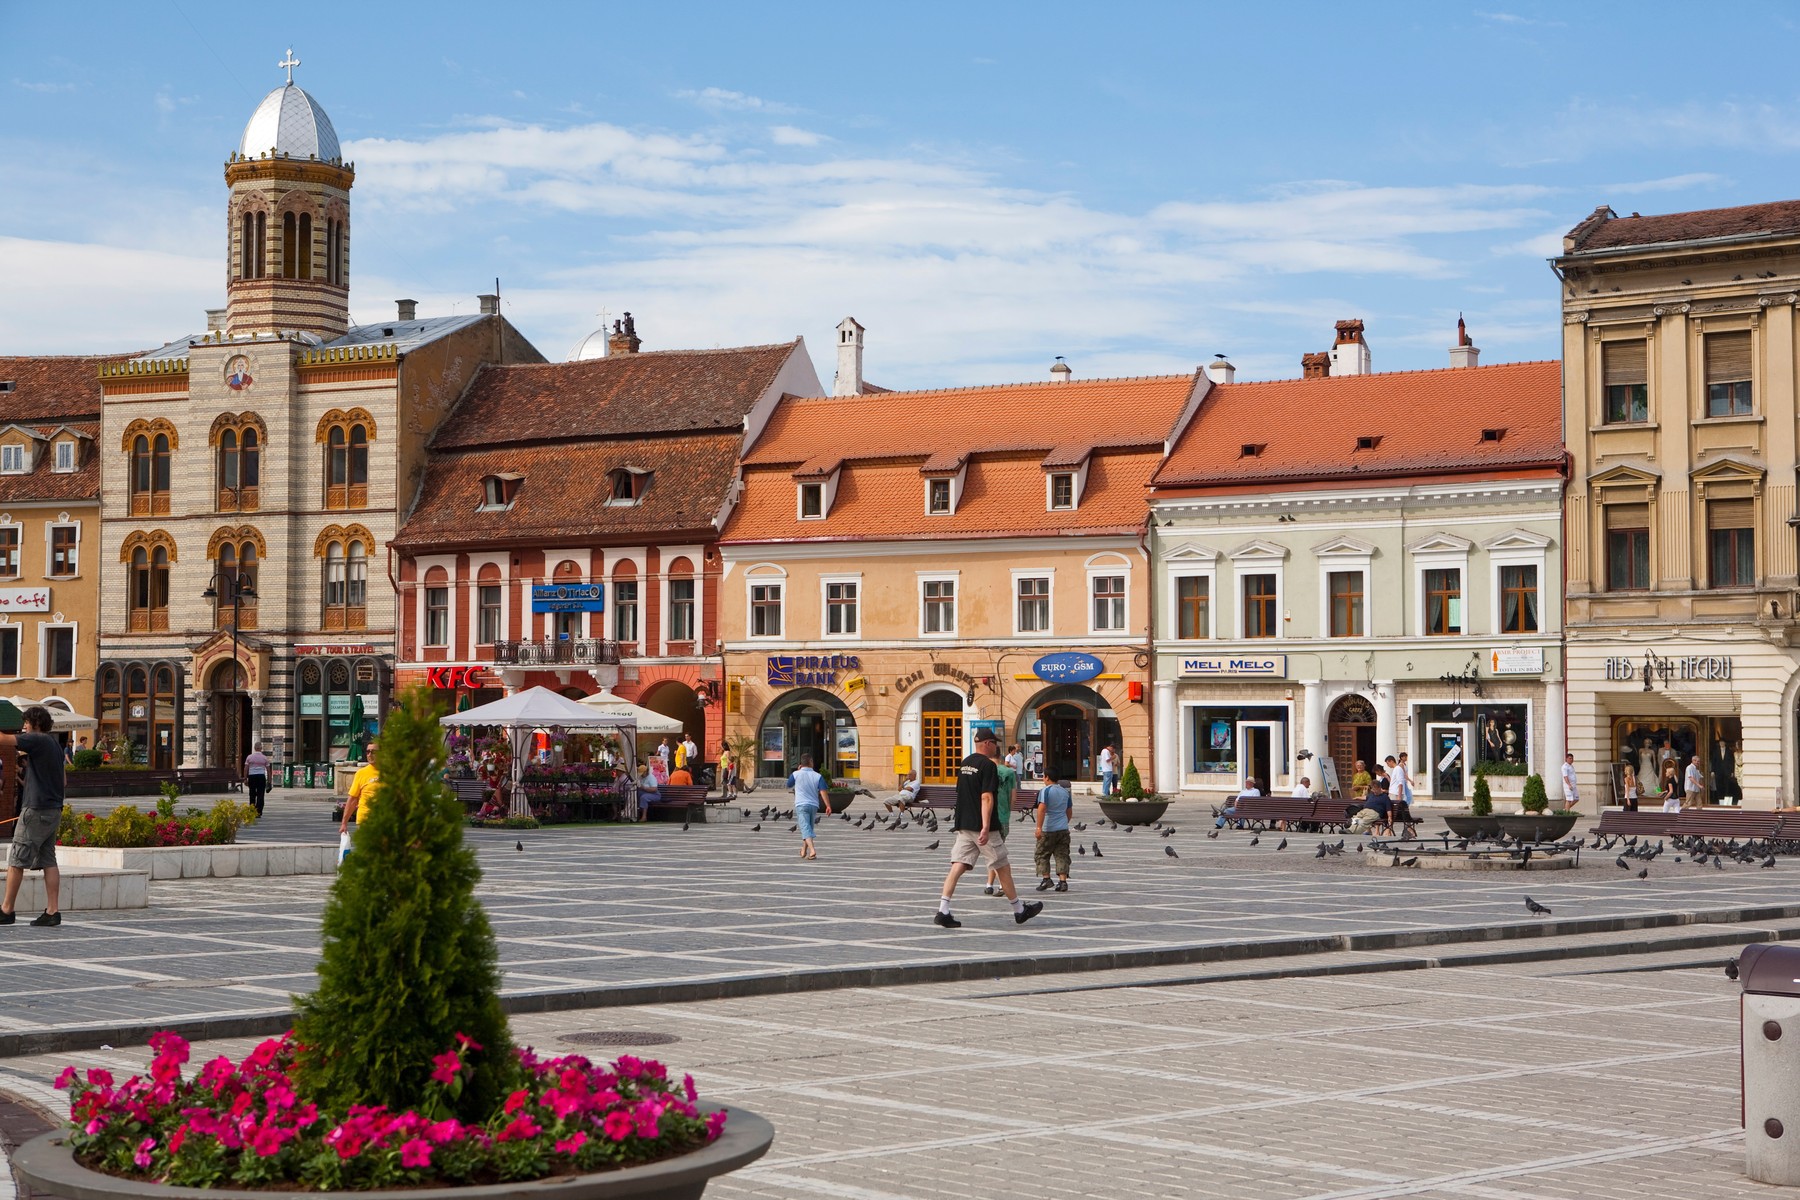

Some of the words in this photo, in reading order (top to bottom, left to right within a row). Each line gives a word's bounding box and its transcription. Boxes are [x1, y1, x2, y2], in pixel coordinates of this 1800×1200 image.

[533, 589, 557, 597] Allianz
[16, 593, 46, 607] Café
[795, 656, 859, 669] PIRAEUS
[1041, 663, 1067, 672] EURO
[1073, 663, 1095, 671] GSM
[1184, 660, 1222, 669] MELI
[1229, 660, 1275, 669] MELO
[1605, 657, 1634, 680] ALB
[1679, 656, 1732, 680] NEGRU
[426, 666, 484, 689] KFC
[795, 672, 836, 685] BANK
[895, 669, 925, 693] Casa
